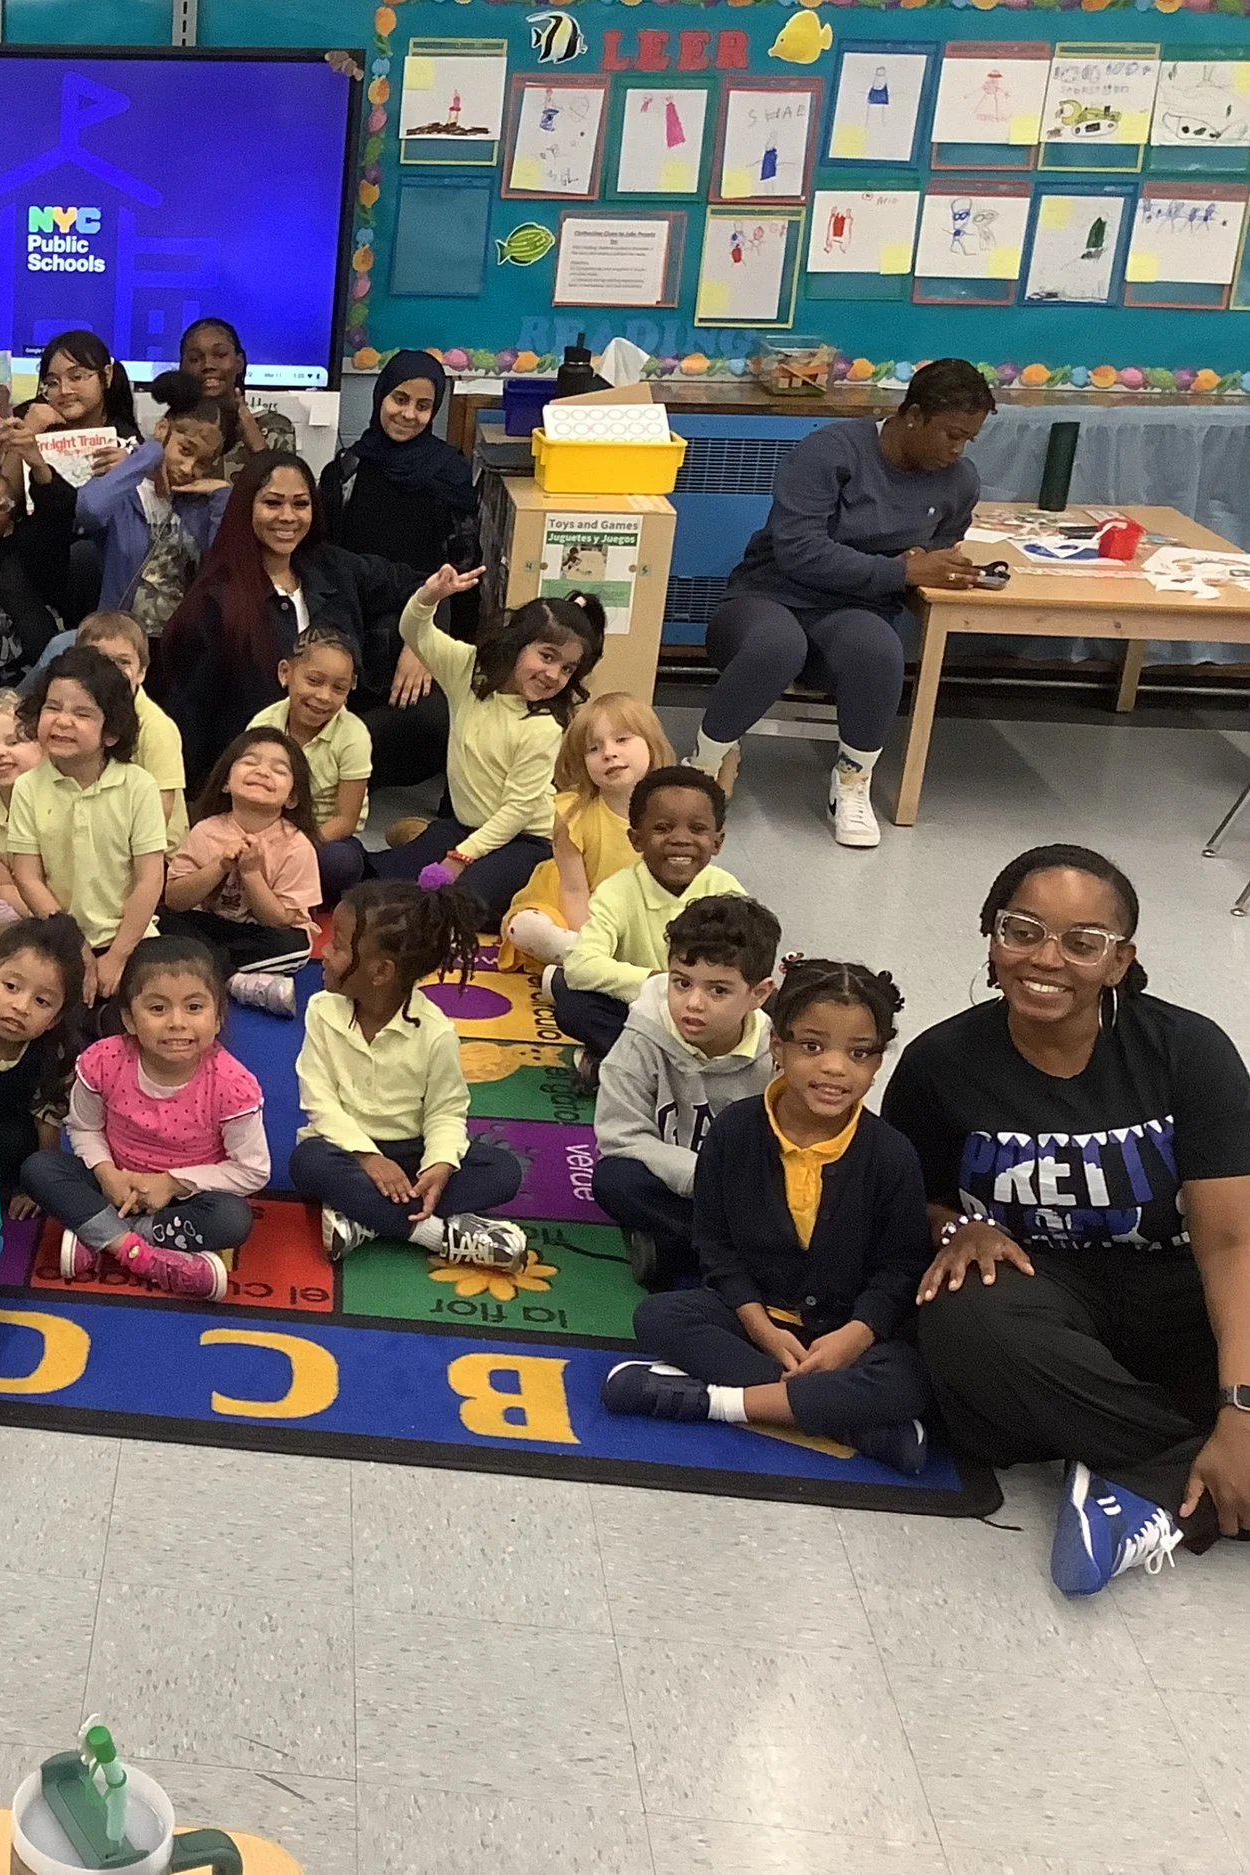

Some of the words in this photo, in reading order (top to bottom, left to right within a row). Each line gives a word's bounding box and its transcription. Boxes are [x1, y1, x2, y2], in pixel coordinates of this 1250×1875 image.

[602, 29, 749, 71] LEER
[28, 206, 101, 234] NYC
[28, 235, 89, 255] Public
[27, 254, 105, 273] Schools
[78, 435, 107, 447] Train
[548, 519, 575, 531] Toys
[577, 520, 598, 529] and
[601, 520, 639, 531] Games
[548, 533, 592, 544] Juguetes
[593, 536, 600, 544] y
[601, 534, 635, 545] Juegos
[959, 1115, 1179, 1206] PRETTY
[289, 1285, 330, 1306] el
[431, 1299, 508, 1326] flor
[522, 1305, 569, 1330] la
[200, 1327, 340, 1419] C
[448, 1352, 582, 1445] B
